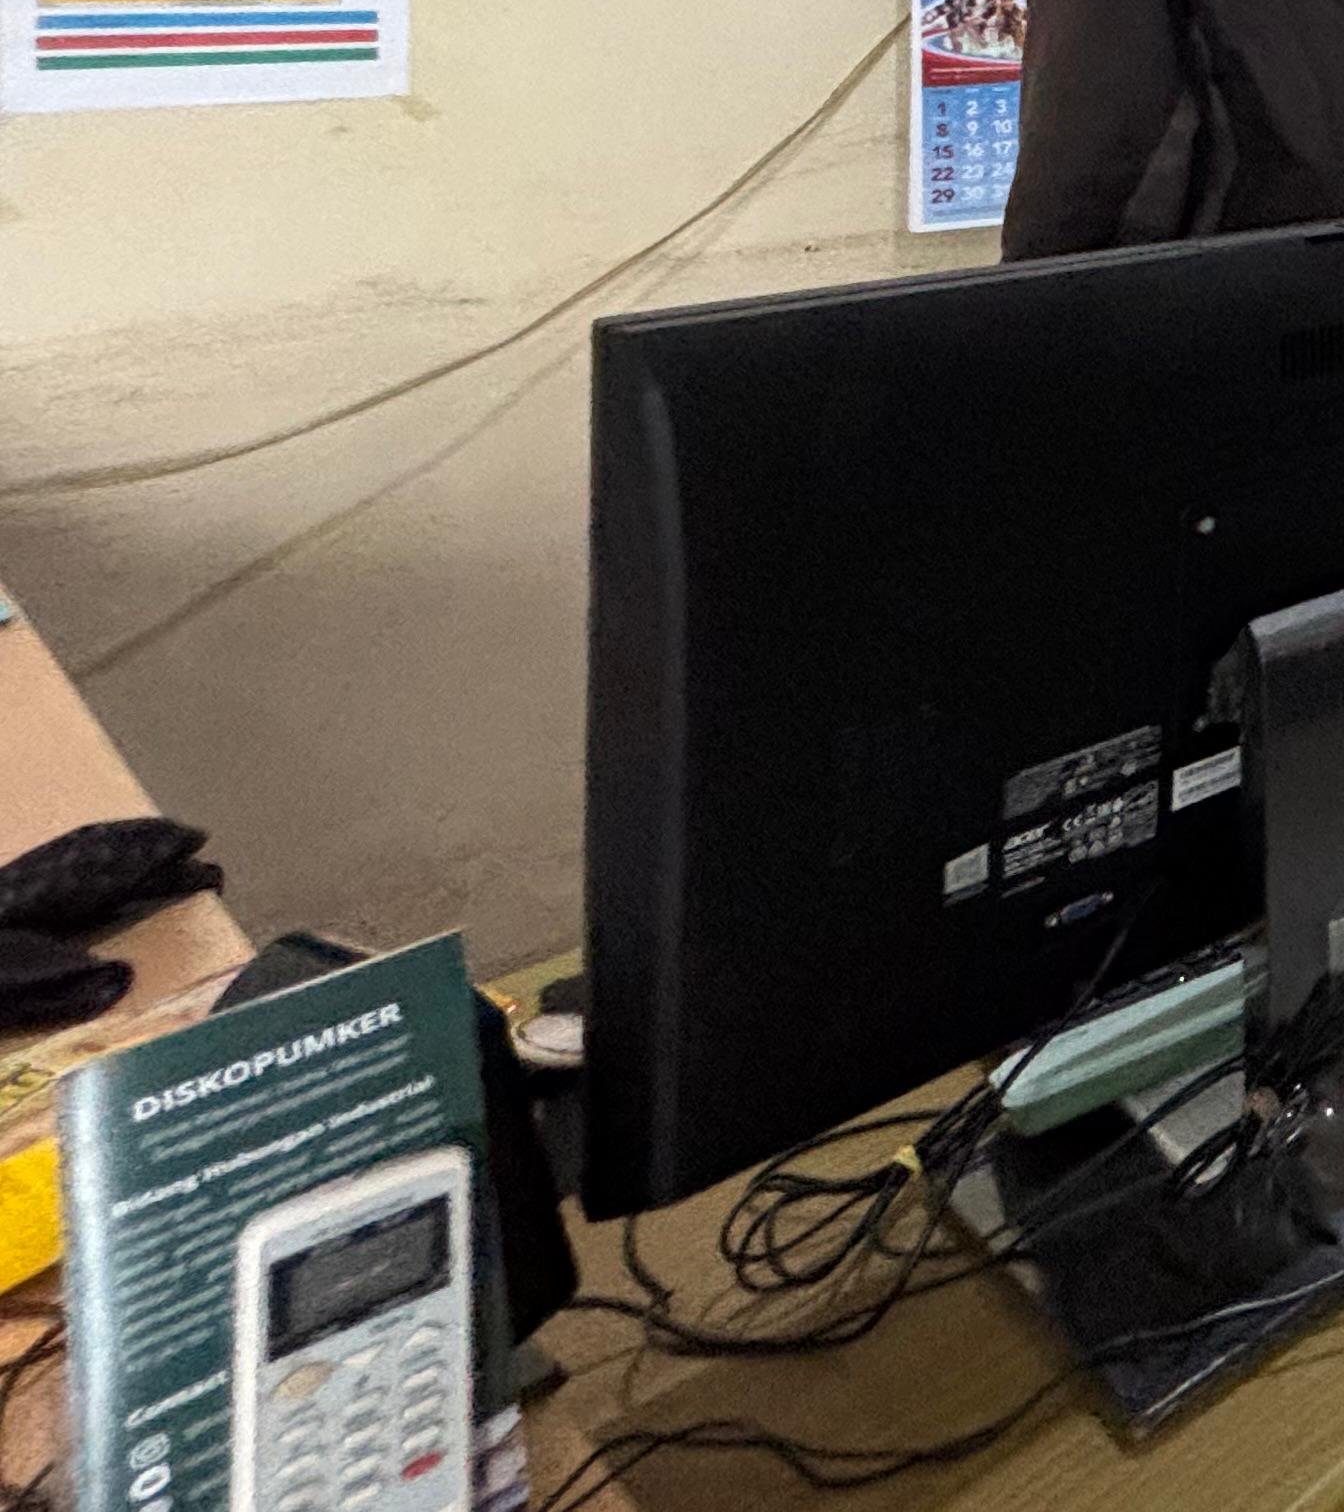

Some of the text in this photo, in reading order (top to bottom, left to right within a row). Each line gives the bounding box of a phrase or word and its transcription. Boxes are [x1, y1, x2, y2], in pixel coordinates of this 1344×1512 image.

[966, 101, 979, 115] 2
[995, 99, 1007, 114] 3
[966, 121, 979, 136] 9
[991, 119, 1012, 134] 10
[932, 145, 954, 159] 15
[931, 166, 954, 181] 22
[931, 189, 955, 204] 29
[132, 1001, 403, 1122] DISKOPUMKER
